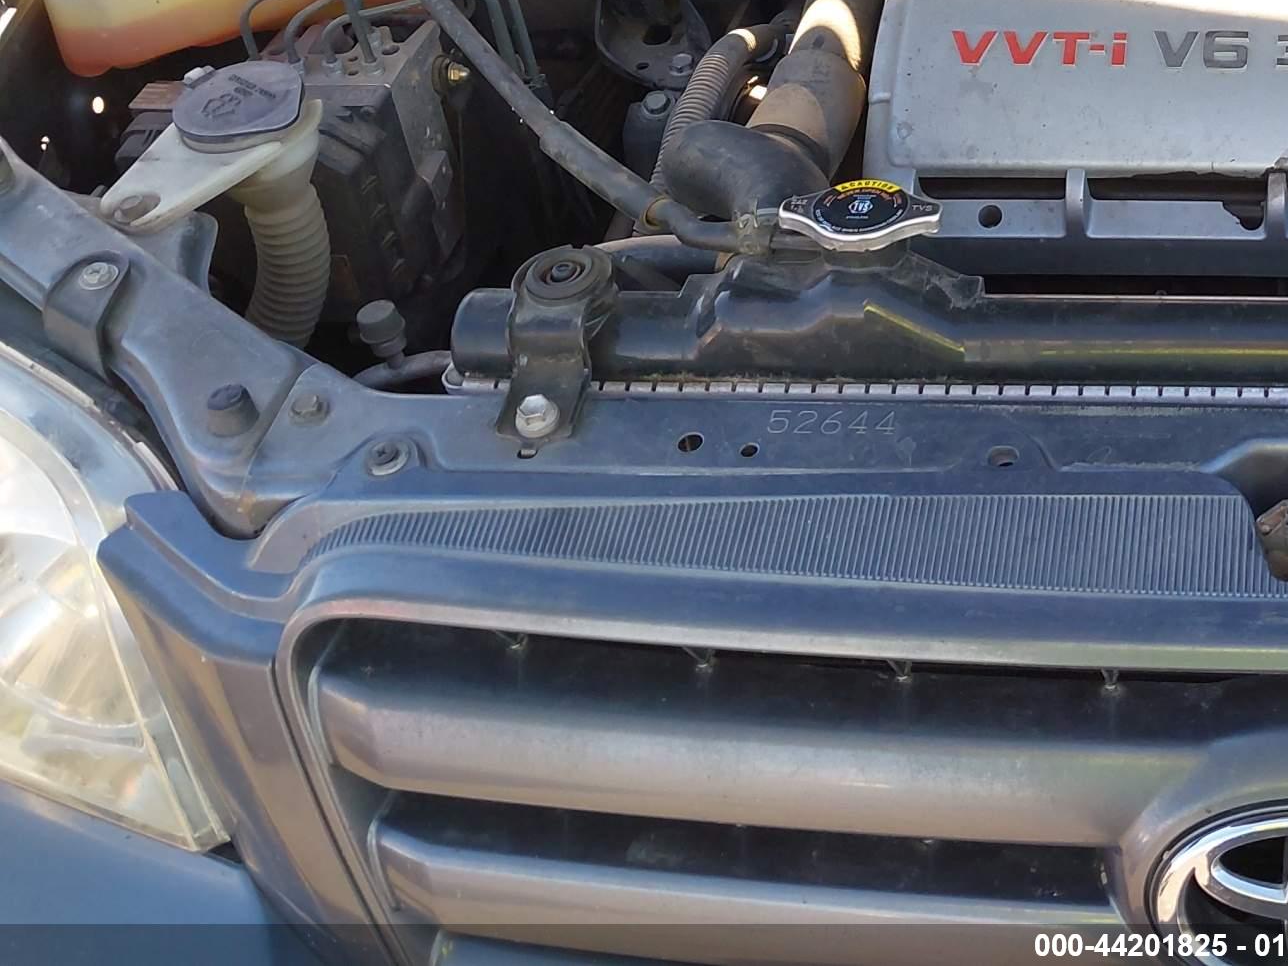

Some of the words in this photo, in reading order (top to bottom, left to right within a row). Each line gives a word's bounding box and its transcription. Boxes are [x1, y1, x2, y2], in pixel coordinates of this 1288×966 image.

[951, 29, 1129, 67] VVT-i
[1153, 30, 1250, 70] V6
[853, 200, 870, 214] TVS
[911, 204, 933, 213] TVS
[767, 409, 896, 435] 52644
